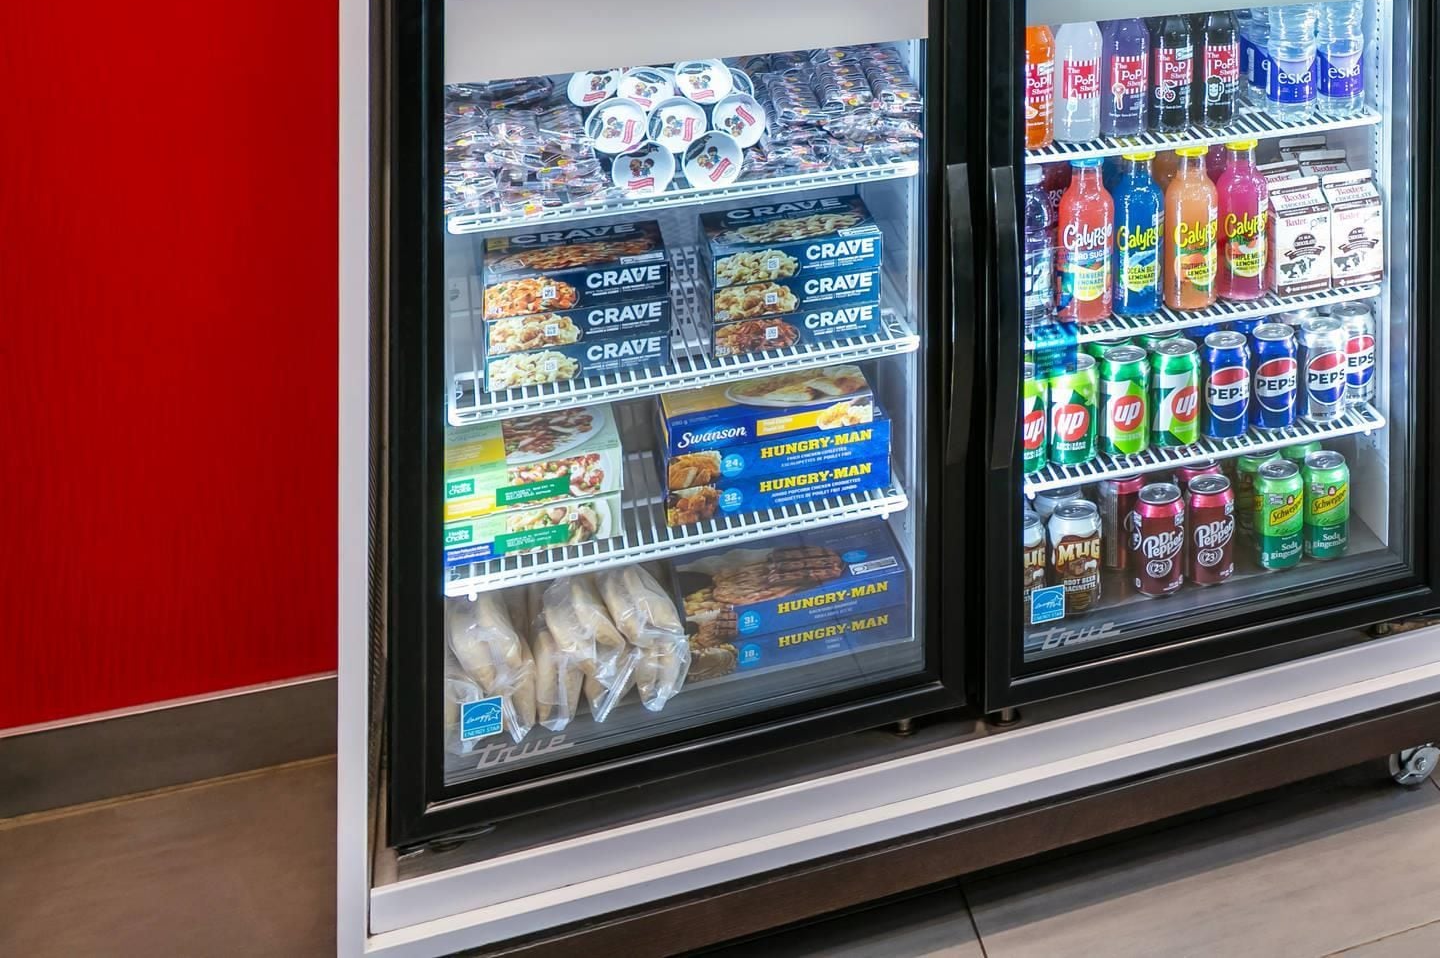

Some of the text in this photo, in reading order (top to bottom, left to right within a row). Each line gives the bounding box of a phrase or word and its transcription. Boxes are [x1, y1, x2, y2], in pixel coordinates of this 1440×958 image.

[1207, 51, 1220, 59] The
[1115, 62, 1128, 70] The
[1328, 64, 1361, 79] eska
[1277, 71, 1312, 84] eska
[1311, 165, 1339, 173] Baxter
[1282, 192, 1311, 203] Baxter
[1335, 186, 1366, 195] Baxter
[727, 198, 843, 220] CRAVE
[1285, 217, 1307, 227] Baxter
[511, 223, 636, 243] CRAVE
[1063, 222, 1113, 251] Calypso
[1174, 219, 1217, 248] Calyps
[806, 238, 875, 261] CRAVE
[586, 265, 661, 289] CRAVE
[804, 272, 873, 295] CRAVE
[588, 302, 662, 326] CRAVE
[805, 306, 873, 330] CRAVE
[586, 337, 661, 362] CRAVE
[1347, 352, 1375, 368] EPS
[1256, 375, 1296, 391] PEPS
[1308, 368, 1346, 385] PEPS
[1207, 384, 1247, 400] PEPS
[677, 426, 746, 449] Swanson
[760, 429, 873, 459] HUNGRY-MAN
[759, 463, 872, 493] HUNGRY-MAN
[448, 486, 472, 496] Choice
[1313, 489, 1347, 513] Schwepp
[1210, 519, 1227, 533] Dr
[446, 533, 470, 542] Choice
[1159, 530, 1176, 543] Dr
[1322, 532, 1341, 542] Soda
[1057, 538, 1101, 568] MUG
[1281, 541, 1298, 551] Soda
[1024, 547, 1046, 569] UG
[1205, 552, 1215, 562] 23
[1153, 563, 1164, 573] 23
[1081, 574, 1097, 584] BEER
[777, 580, 889, 614] HUNGRY-MAN
[778, 614, 889, 648] HUNGRY-MAN
[464, 725, 501, 738] ENERGY STAR
